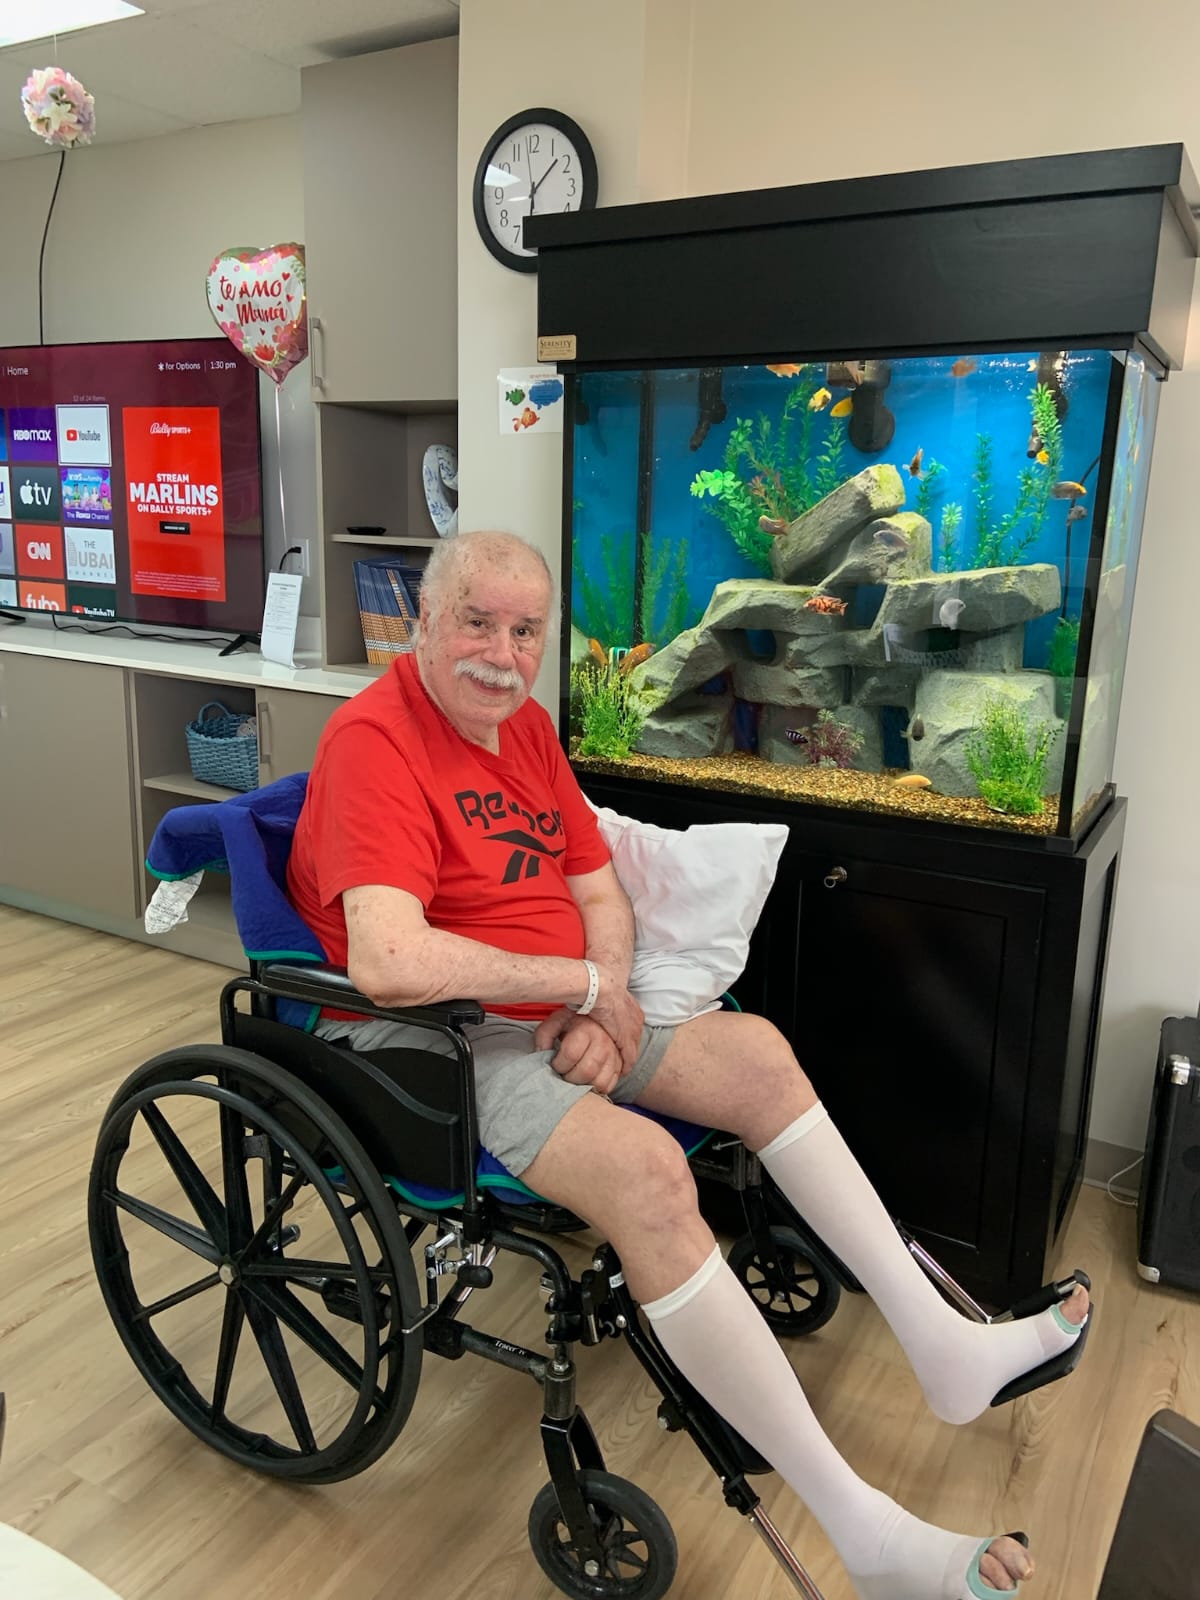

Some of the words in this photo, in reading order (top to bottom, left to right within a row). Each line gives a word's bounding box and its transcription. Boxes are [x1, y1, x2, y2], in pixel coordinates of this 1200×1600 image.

[512, 143, 521, 162] 11
[529, 134, 540, 153] 12
[562, 154, 571, 173] 2
[494, 186, 504, 205] 9
[567, 177, 576, 197] 3
[500, 209, 508, 228] 8
[512, 225, 521, 243] 7
[7, 366, 29, 376] Home
[175, 362, 200, 371] Options
[210, 361, 224, 369] 1:30
[225, 362, 236, 370] pm
[79, 430, 101, 441] YouTube
[156, 473, 190, 483] STREAM
[33, 482, 52, 506] tv
[129, 482, 219, 507] MARLINS
[137, 504, 149, 513] ON
[150, 505, 175, 514] BALLY
[176, 506, 212, 516] SPORTS+
[27, 542, 52, 561] CNN
[84, 540, 97, 549] THE
